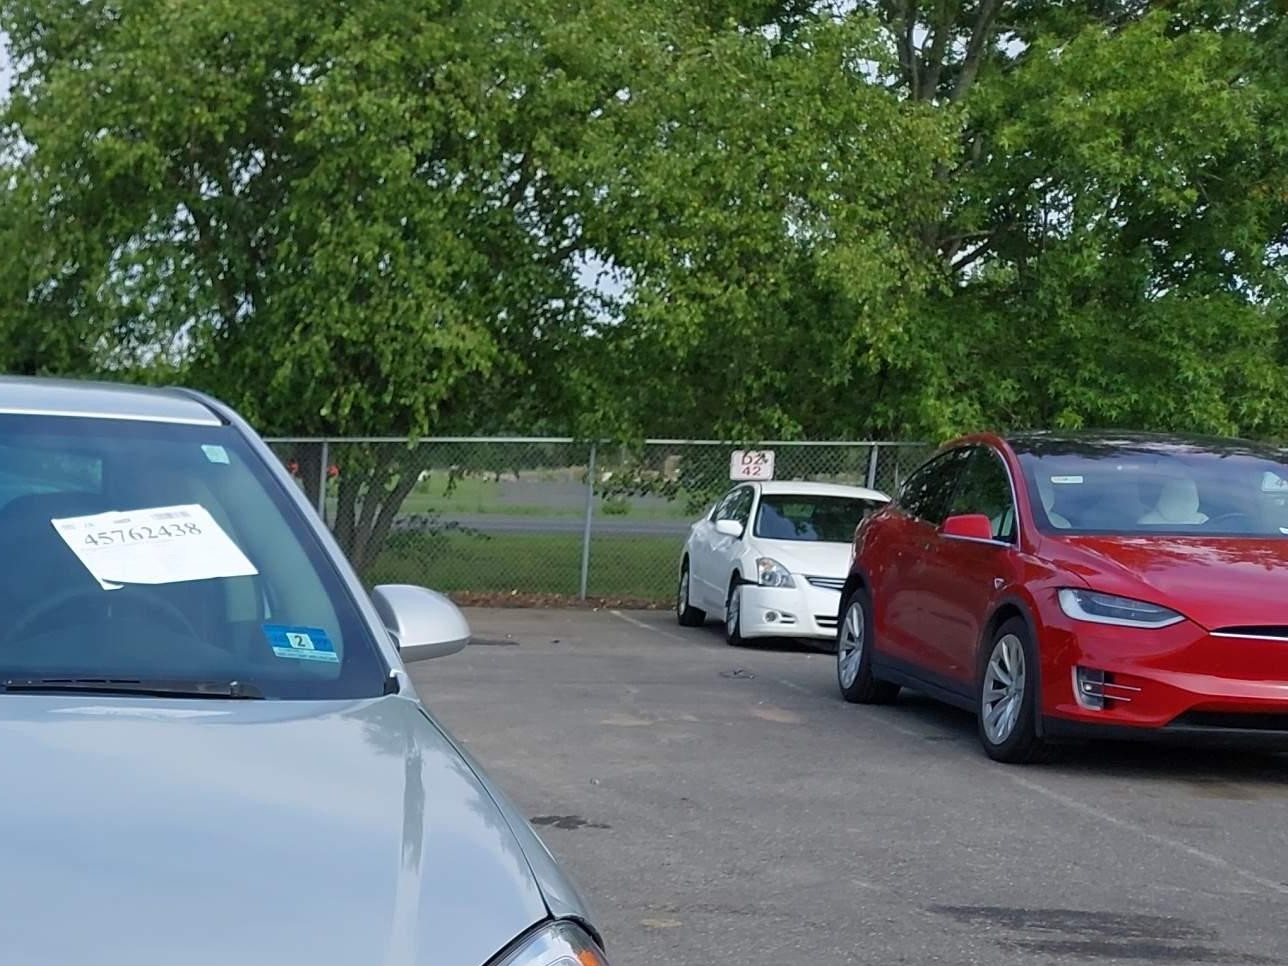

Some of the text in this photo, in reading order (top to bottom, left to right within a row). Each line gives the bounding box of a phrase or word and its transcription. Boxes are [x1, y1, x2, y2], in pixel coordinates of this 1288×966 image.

[742, 466, 761, 476] 42
[84, 522, 202, 546] 45762438
[294, 635, 306, 647] 2
